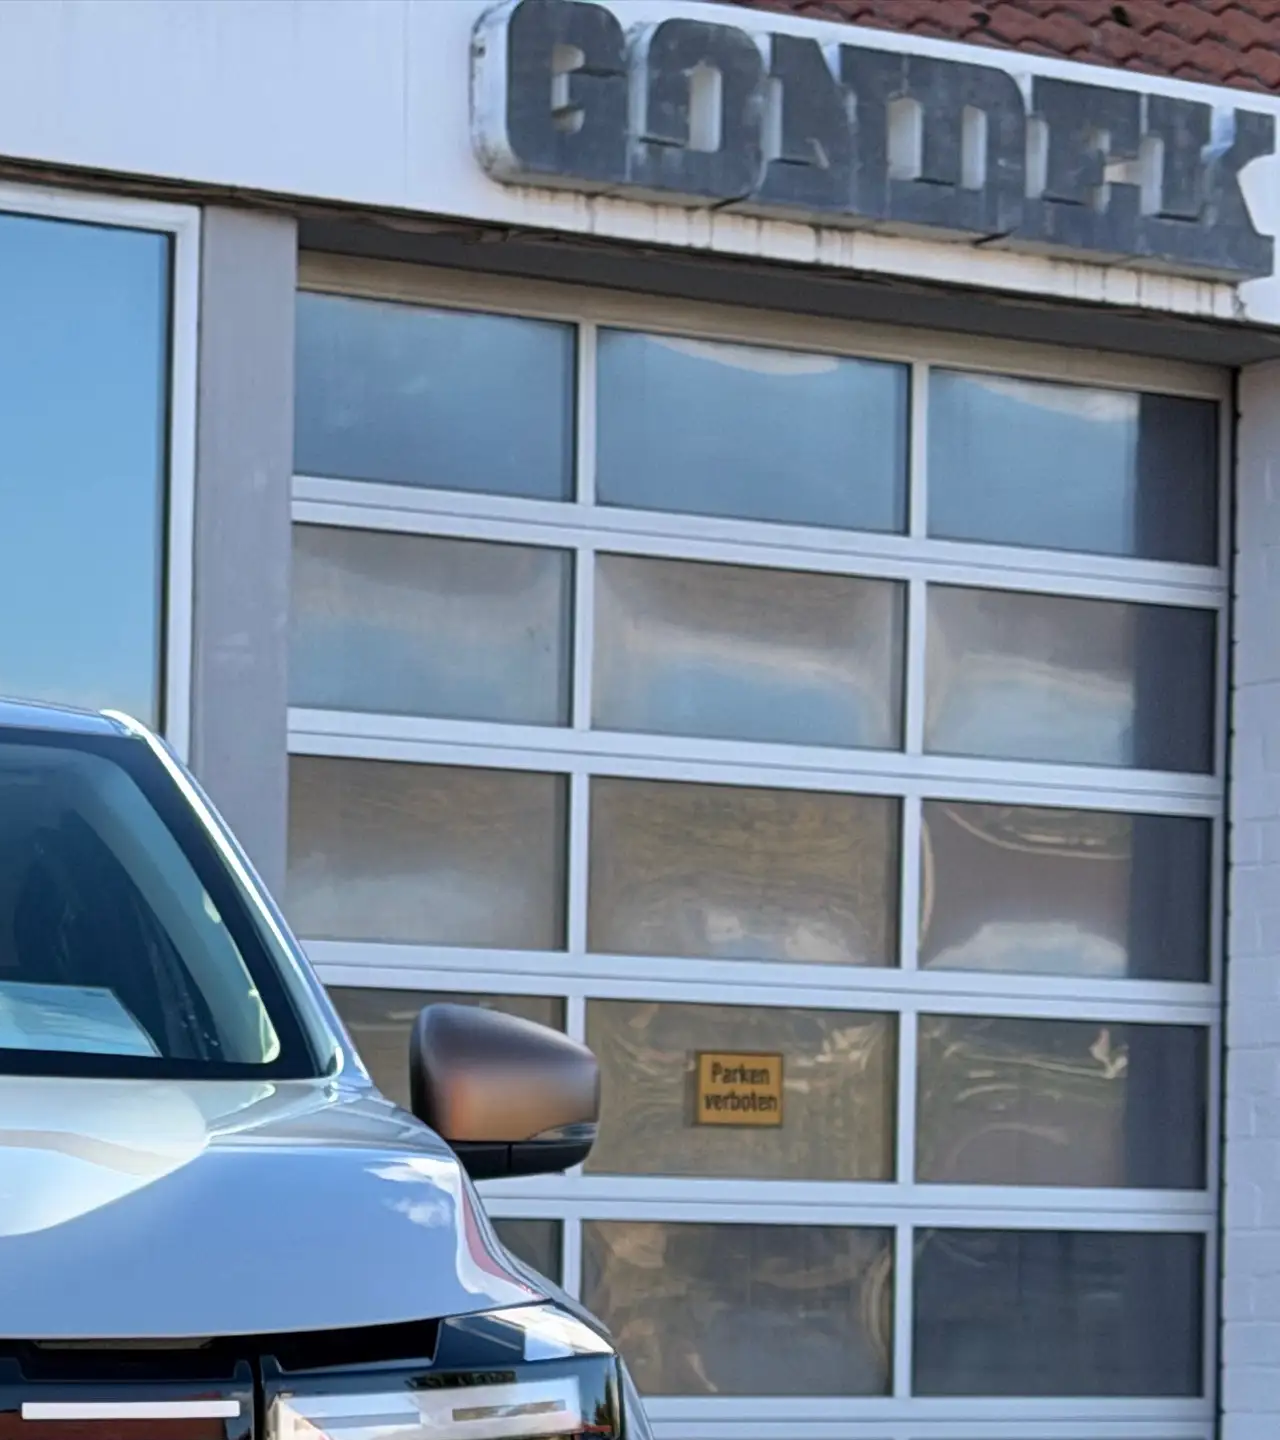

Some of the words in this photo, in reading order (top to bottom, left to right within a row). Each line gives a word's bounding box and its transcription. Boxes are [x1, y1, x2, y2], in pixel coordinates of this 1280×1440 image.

[502, 0, 1276, 280] GONDEK
[711, 1061, 771, 1085] Parken
[704, 1088, 778, 1112] verboten
